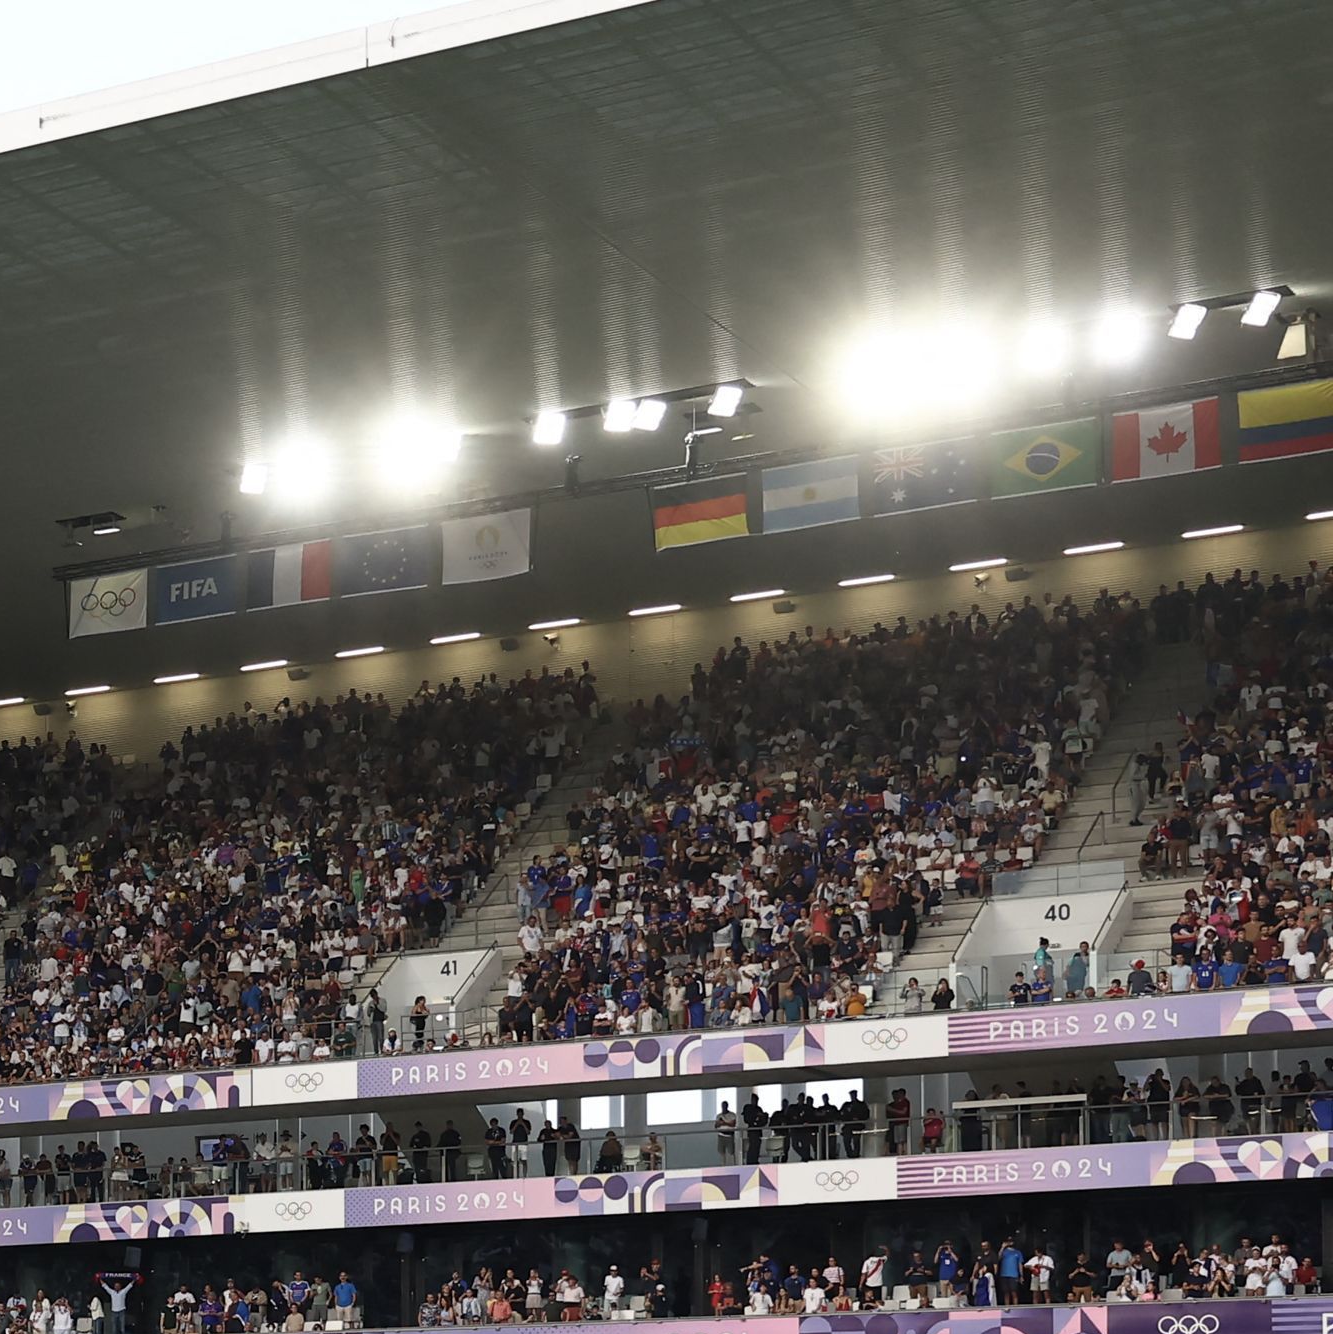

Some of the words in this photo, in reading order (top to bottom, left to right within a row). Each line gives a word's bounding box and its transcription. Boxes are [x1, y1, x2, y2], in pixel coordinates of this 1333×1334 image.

[170, 577, 218, 602] FIFA
[1044, 903, 1071, 922] 40
[440, 959, 458, 977] 41
[1092, 1008, 1179, 1034] 2024
[478, 1056, 550, 1080] 2024
[1032, 1157, 1113, 1182] 2024
[457, 1190, 525, 1212] 2024
